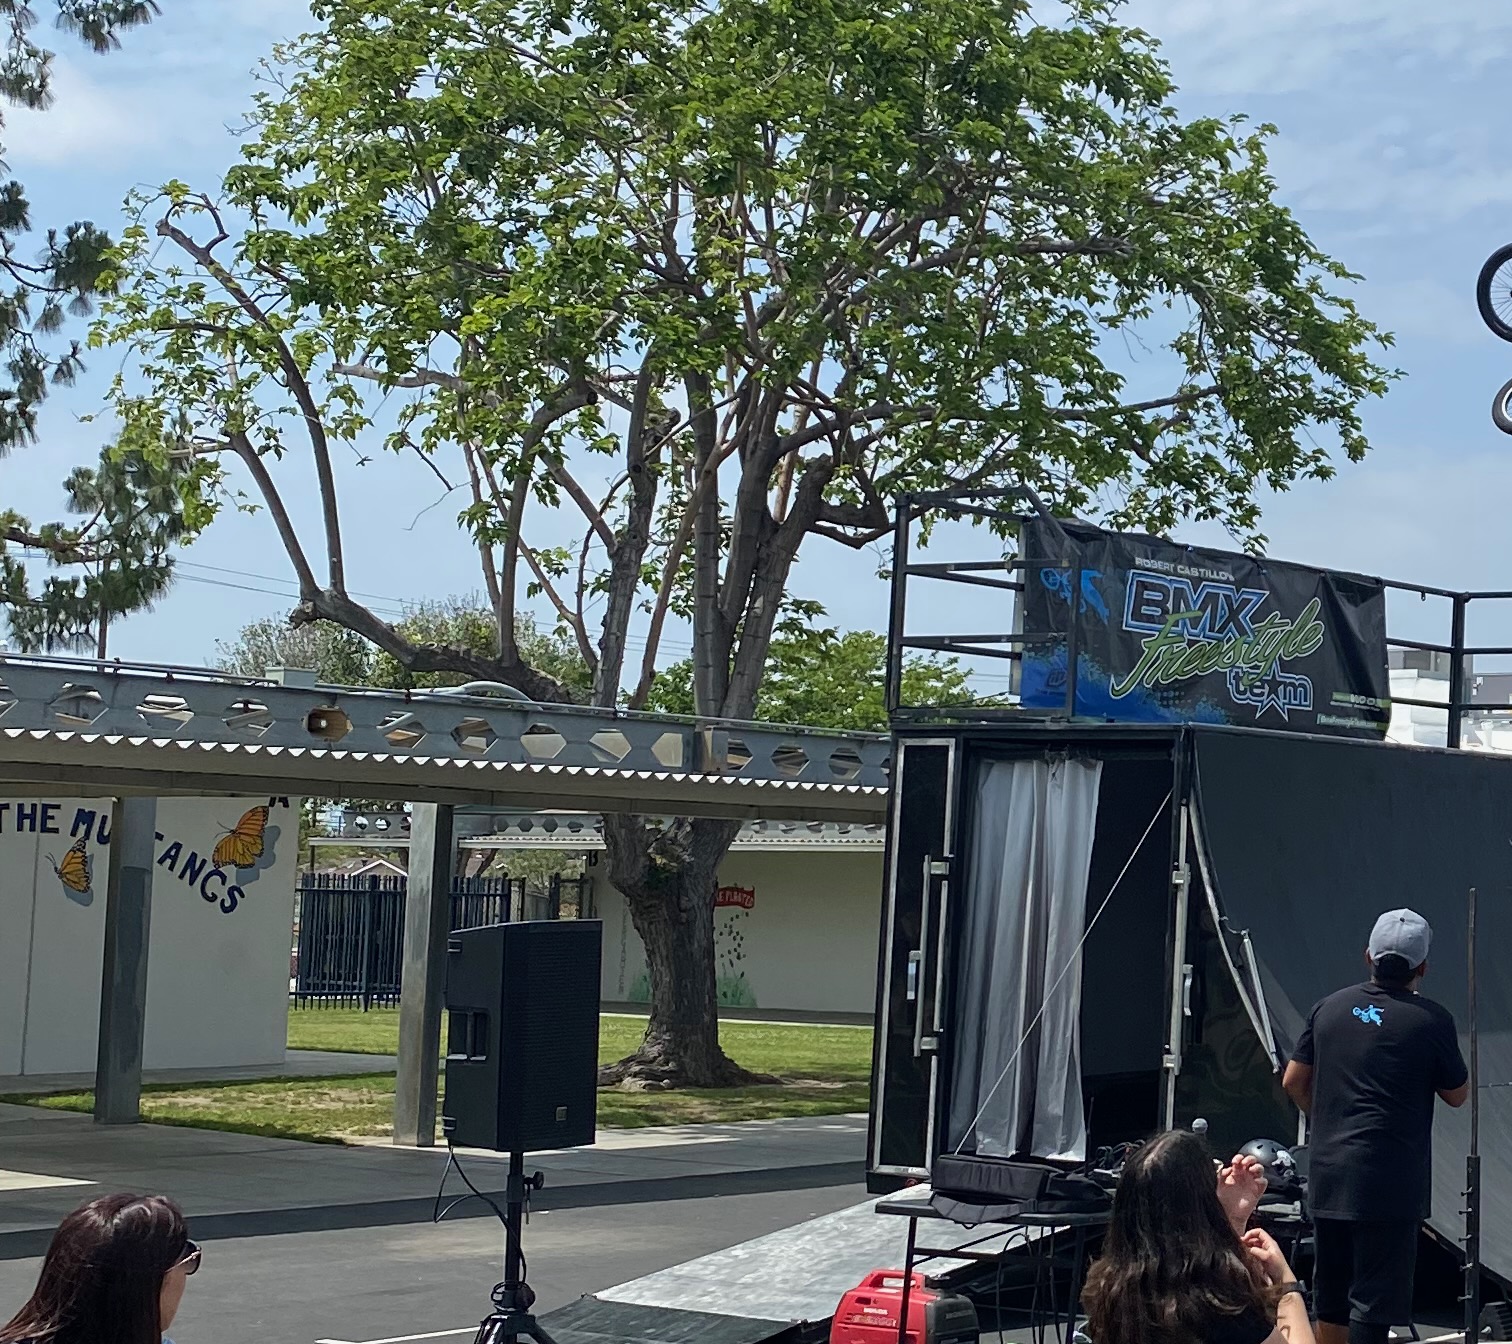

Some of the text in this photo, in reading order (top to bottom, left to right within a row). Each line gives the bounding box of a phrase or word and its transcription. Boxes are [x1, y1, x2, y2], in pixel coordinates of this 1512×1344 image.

[1135, 557, 1174, 573] ROBERT
[1123, 570, 1270, 642] BMX
[1109, 597, 1325, 699] Freestyle
